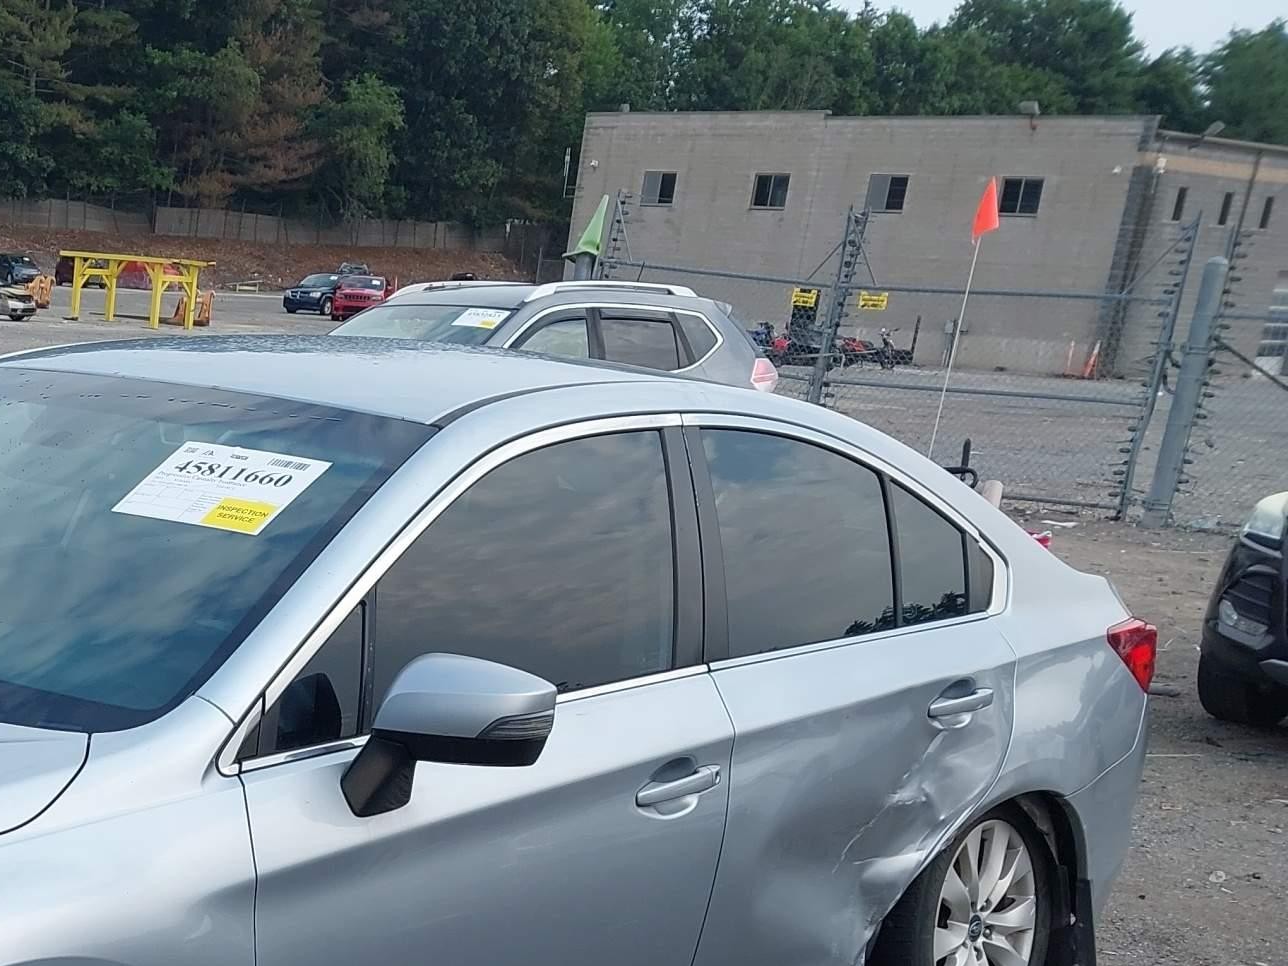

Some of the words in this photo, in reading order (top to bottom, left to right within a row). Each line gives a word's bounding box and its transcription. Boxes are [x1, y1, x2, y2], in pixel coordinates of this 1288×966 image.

[174, 459, 293, 488] 45811660
[216, 511, 255, 523] SERVICE
[217, 504, 269, 518] INSPECTION
